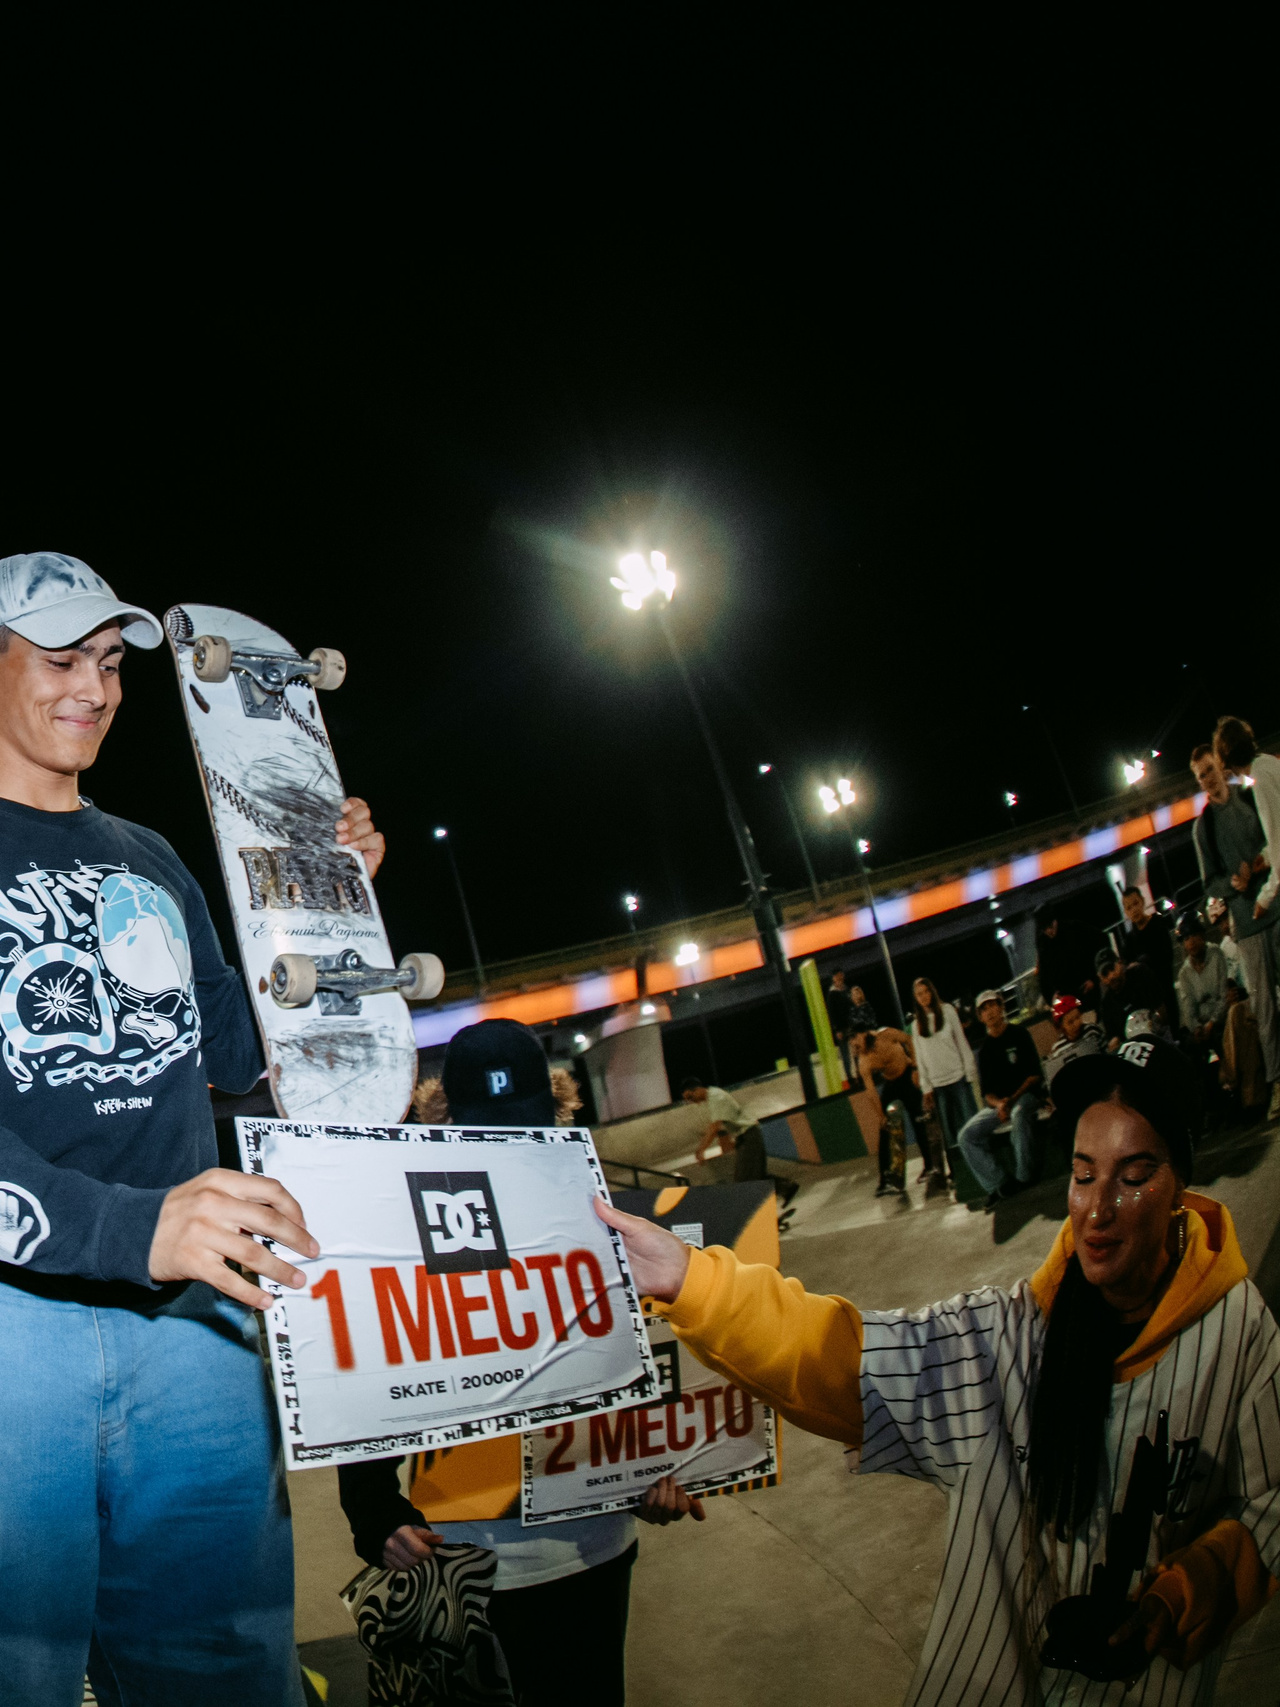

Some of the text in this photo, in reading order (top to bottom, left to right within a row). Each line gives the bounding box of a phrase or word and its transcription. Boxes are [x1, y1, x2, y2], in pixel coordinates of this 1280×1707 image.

[248, 921, 317, 939] Еений
[243, 1121, 325, 1136] SHOECOUS
[421, 1190, 497, 1254] DC
[311, 1248, 614, 1372] 1 МЕСТО
[390, 1380, 447, 1400] SKATE
[544, 1421, 576, 1475] 2
[589, 1383, 754, 1468] МЕСТО
[586, 1474, 623, 1488] SKATE
